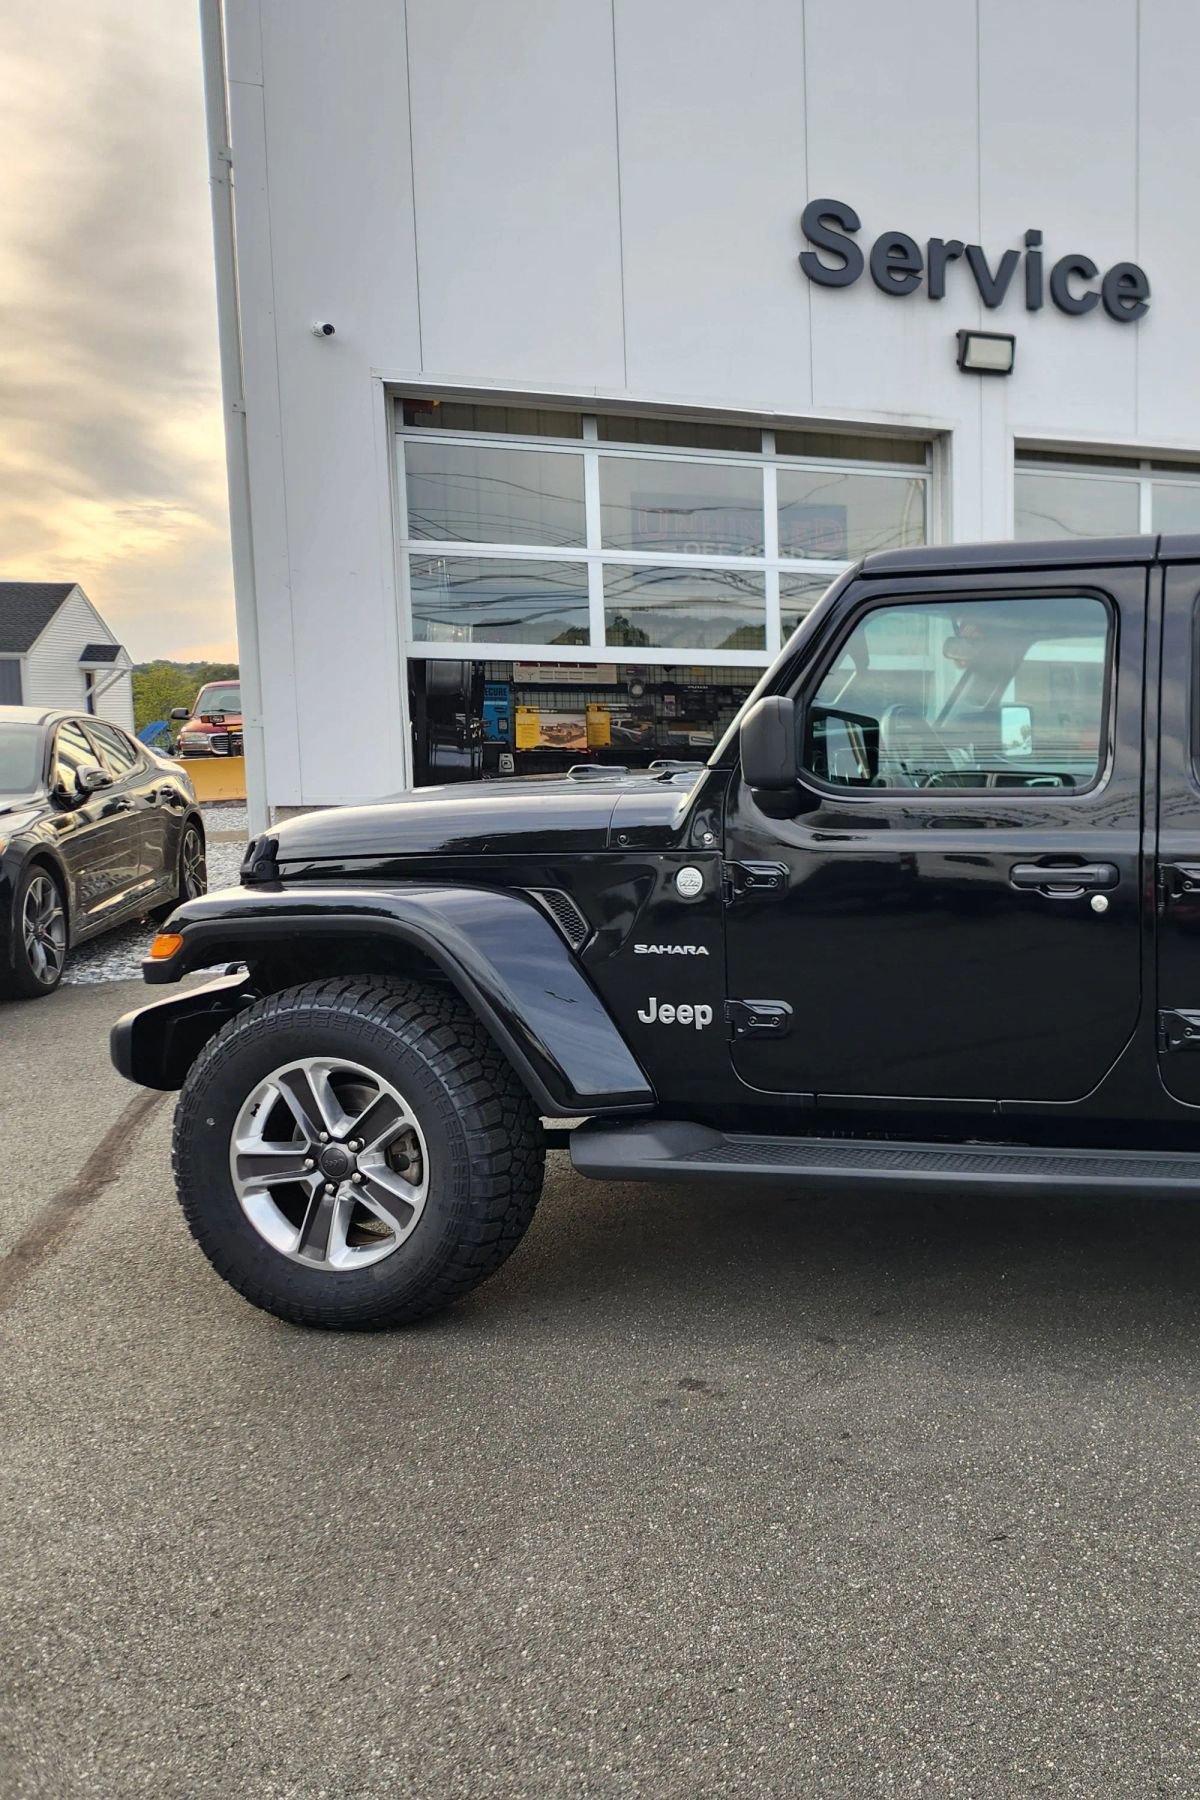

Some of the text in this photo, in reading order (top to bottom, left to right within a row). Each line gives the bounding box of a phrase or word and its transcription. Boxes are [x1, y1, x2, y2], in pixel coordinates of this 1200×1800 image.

[799, 198, 1151, 322] Service
[639, 507, 843, 552] UNHINED
[634, 944, 709, 955] SAHARA
[637, 997, 713, 1030] Jeep
